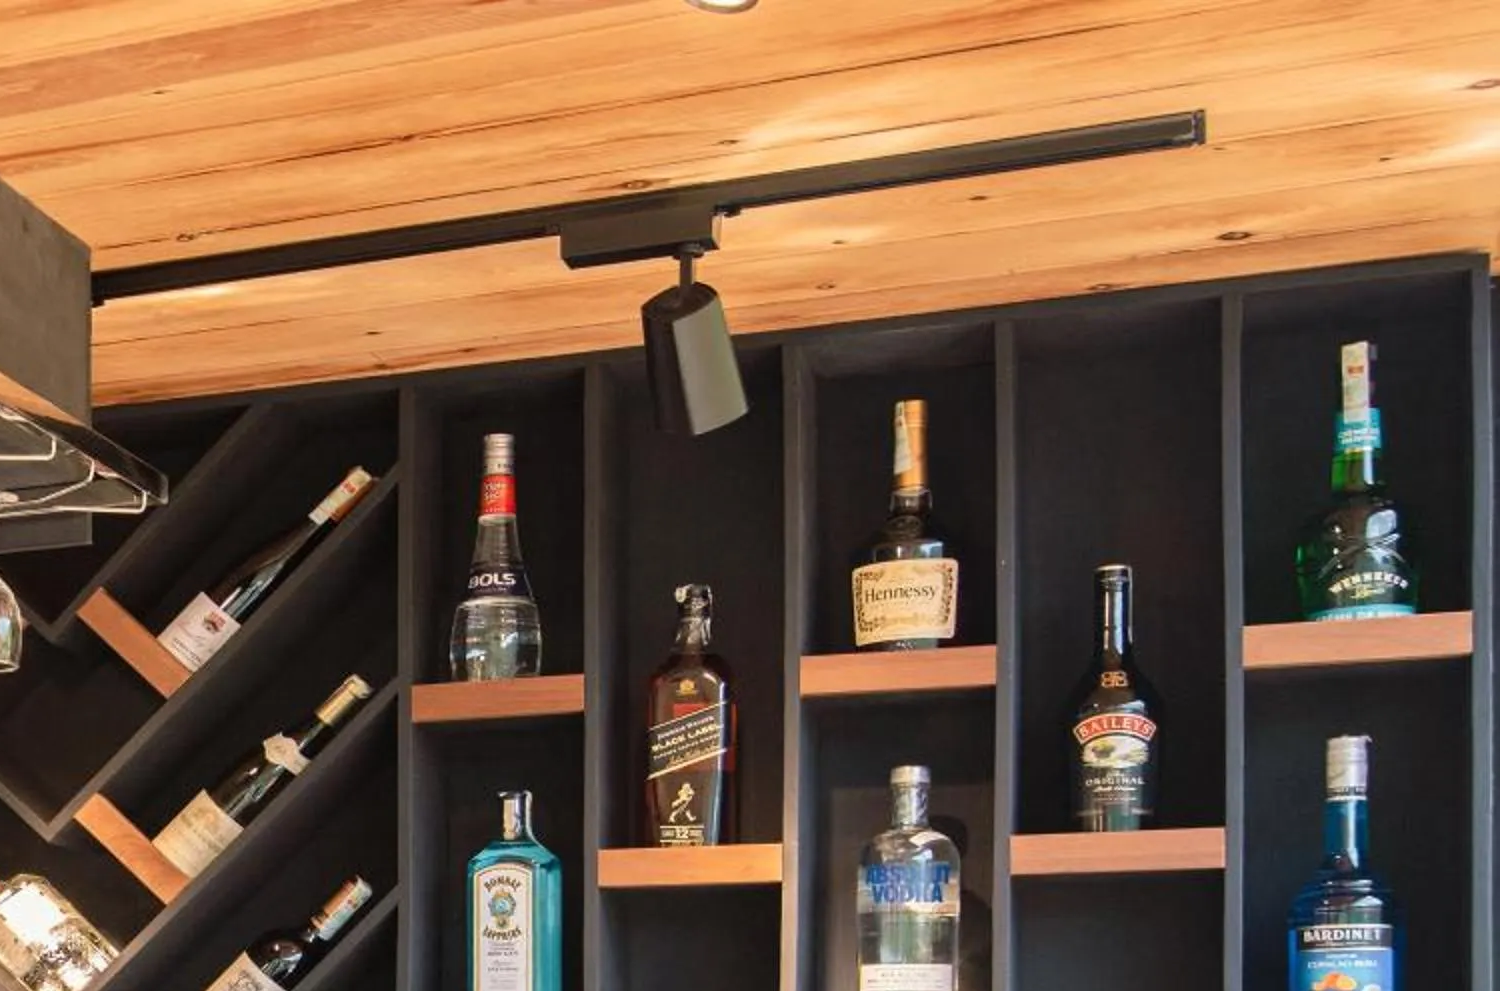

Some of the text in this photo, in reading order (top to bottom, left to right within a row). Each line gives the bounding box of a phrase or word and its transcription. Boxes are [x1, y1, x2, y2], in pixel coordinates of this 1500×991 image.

[467, 573, 517, 589] BOLS
[864, 584, 936, 603] Hennessy
[1078, 715, 1152, 738] BAILEYS
[651, 733, 686, 752] BLACK
[1303, 928, 1381, 943] BARDINET
